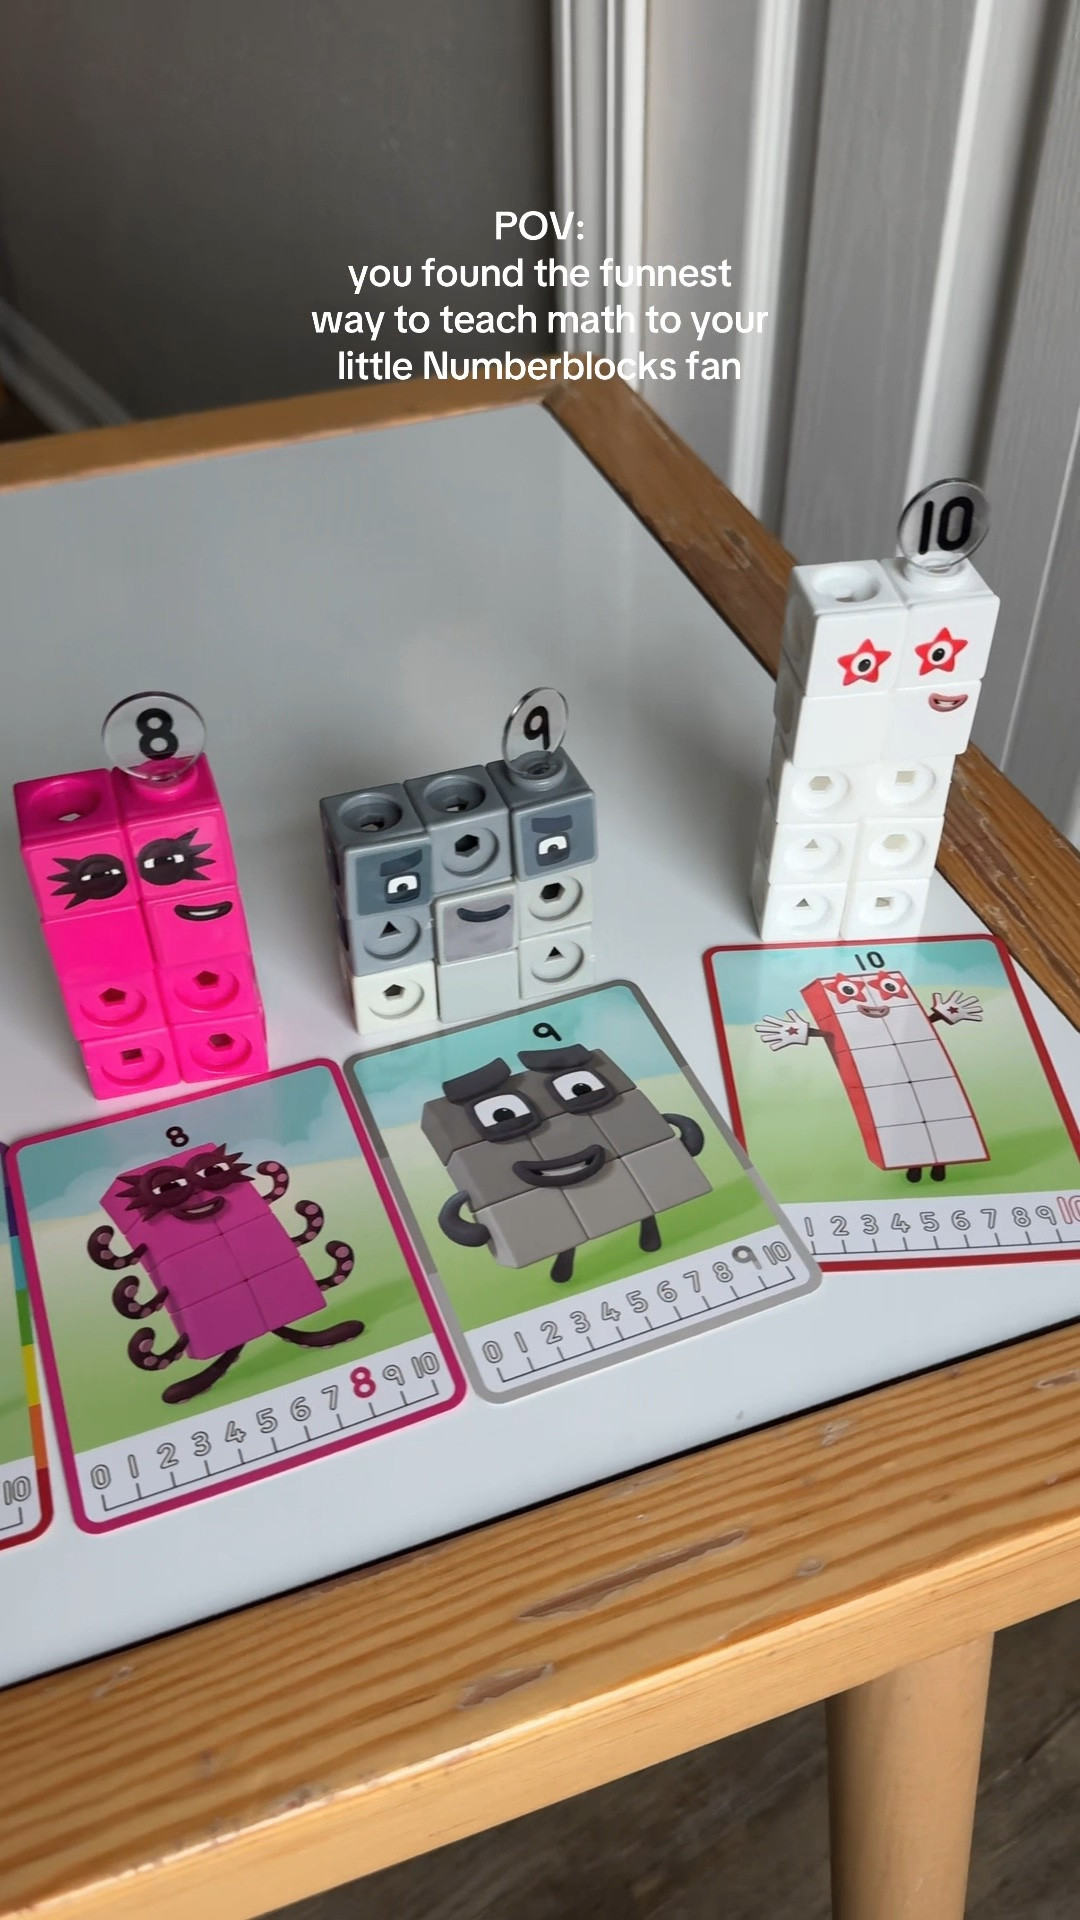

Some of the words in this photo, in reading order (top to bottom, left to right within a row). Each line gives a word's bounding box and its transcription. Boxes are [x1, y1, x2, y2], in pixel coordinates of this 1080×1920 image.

[918, 496, 974, 556] 10
[135, 707, 179, 760] 8
[523, 705, 551, 750] 9
[854, 951, 886, 971] 10
[532, 1022, 562, 1042] 9
[165, 1126, 189, 1147] 8
[804, 1216, 815, 1238] 1
[830, 1215, 850, 1236] 2
[860, 1214, 879, 1235] 3
[890, 1212, 911, 1233] 4
[919, 1211, 940, 1232] 5
[951, 1210, 971, 1231] 6
[980, 1208, 997, 1229] 7
[1012, 1206, 1031, 1228] 8
[1035, 1205, 1058, 1226] 9
[482, 1340, 504, 1364] 0
[514, 1331, 528, 1354] 1
[540, 1320, 563, 1345] 2
[569, 1310, 592, 1334] 3
[600, 1301, 622, 1323] 4
[625, 1290, 649, 1314] 5
[656, 1280, 679, 1303] 6
[683, 1270, 701, 1294] 7
[712, 1261, 734, 1283] 8
[732, 1245, 763, 1271] 9
[762, 1241, 792, 1266] 10
[90, 1463, 112, 1491] 0
[127, 1454, 140, 1479] 1
[156, 1442, 179, 1470] 2
[191, 1431, 212, 1458] 3
[225, 1420, 247, 1444] 4
[256, 1407, 279, 1434] 5
[290, 1396, 312, 1422] 6
[322, 1384, 341, 1411] 7
[349, 1366, 378, 1400] 8
[382, 1364, 407, 1387] 9
[410, 1351, 442, 1380] 10
[2, 1475, 32, 1506] 10
